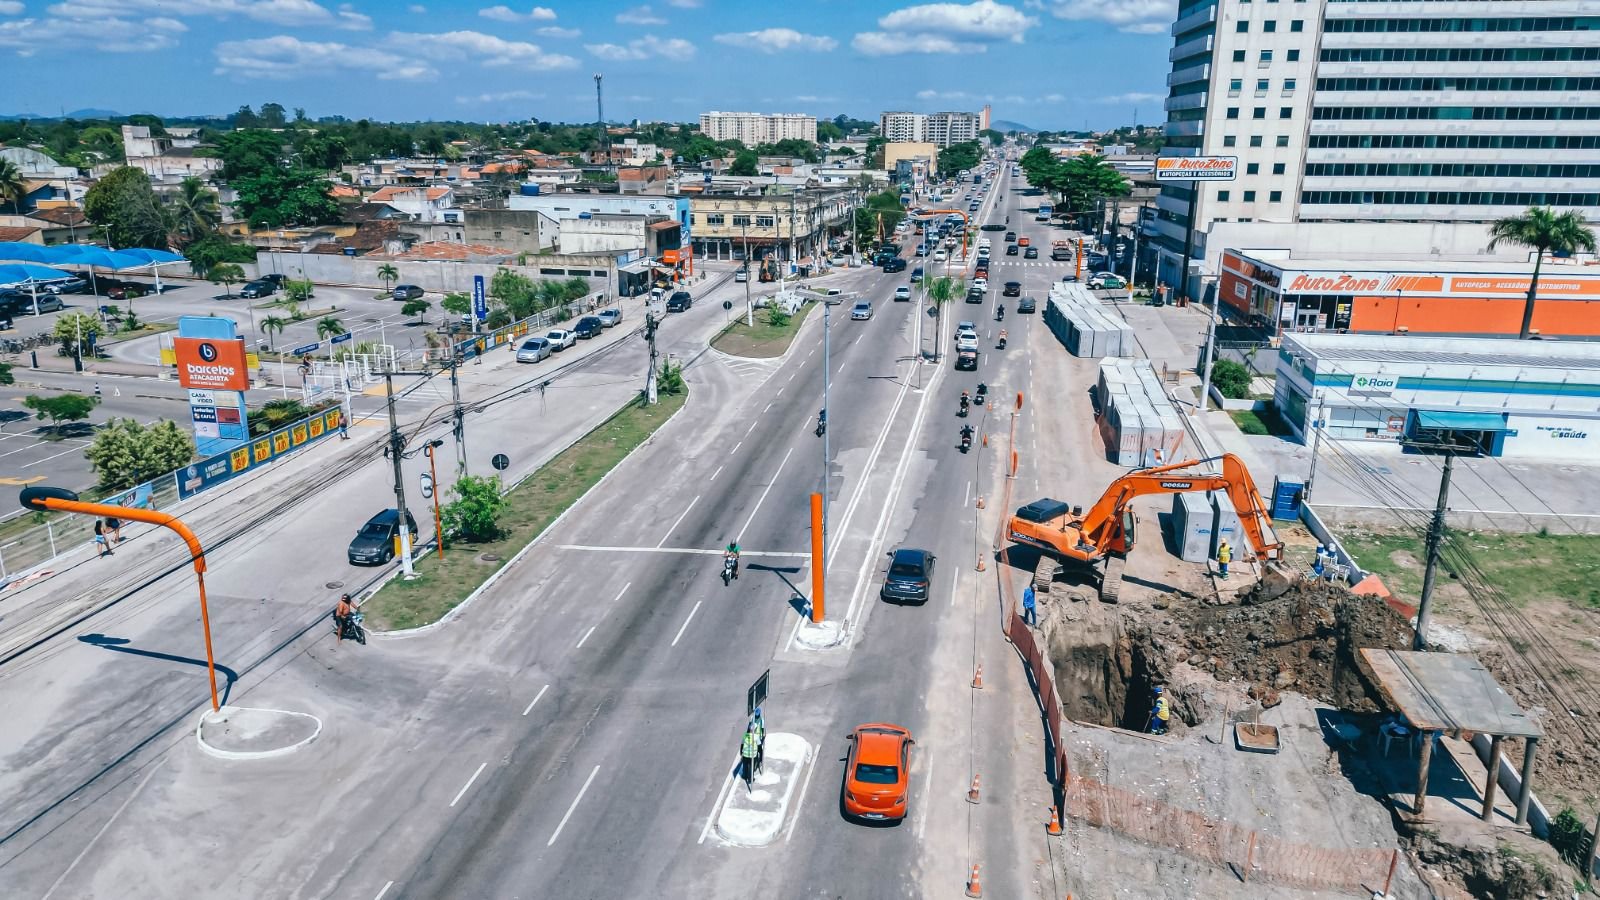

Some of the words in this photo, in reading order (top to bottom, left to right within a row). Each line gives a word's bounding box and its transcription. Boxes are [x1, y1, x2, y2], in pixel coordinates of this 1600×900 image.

[1179, 159, 1233, 169] AutoZone
[1289, 275, 1380, 291] AutoZone
[187, 364, 235, 376] barcelos
[190, 374, 229, 382] ATACADISTA
[1368, 378, 1393, 387] Raia
[1559, 431, 1587, 439] saúde
